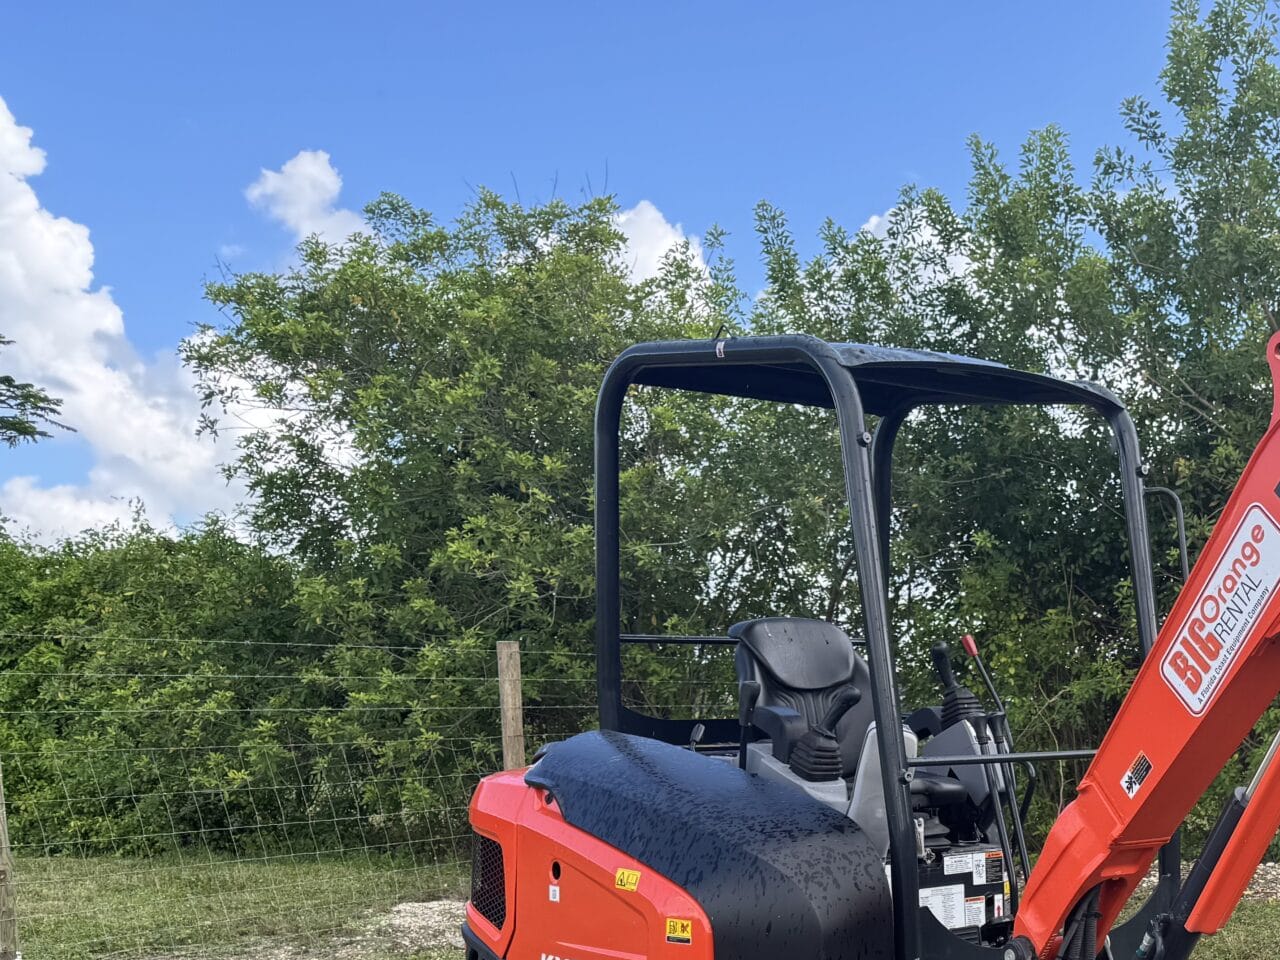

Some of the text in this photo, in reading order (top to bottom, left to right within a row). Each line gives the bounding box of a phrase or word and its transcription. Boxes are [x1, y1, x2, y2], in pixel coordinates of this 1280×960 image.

[1200, 673, 1217, 699] Florida
[1214, 654, 1229, 675] Coast
[1226, 618, 1251, 658] Equipment
[1247, 585, 1270, 620] Company
[1213, 573, 1263, 644] RENTAL
